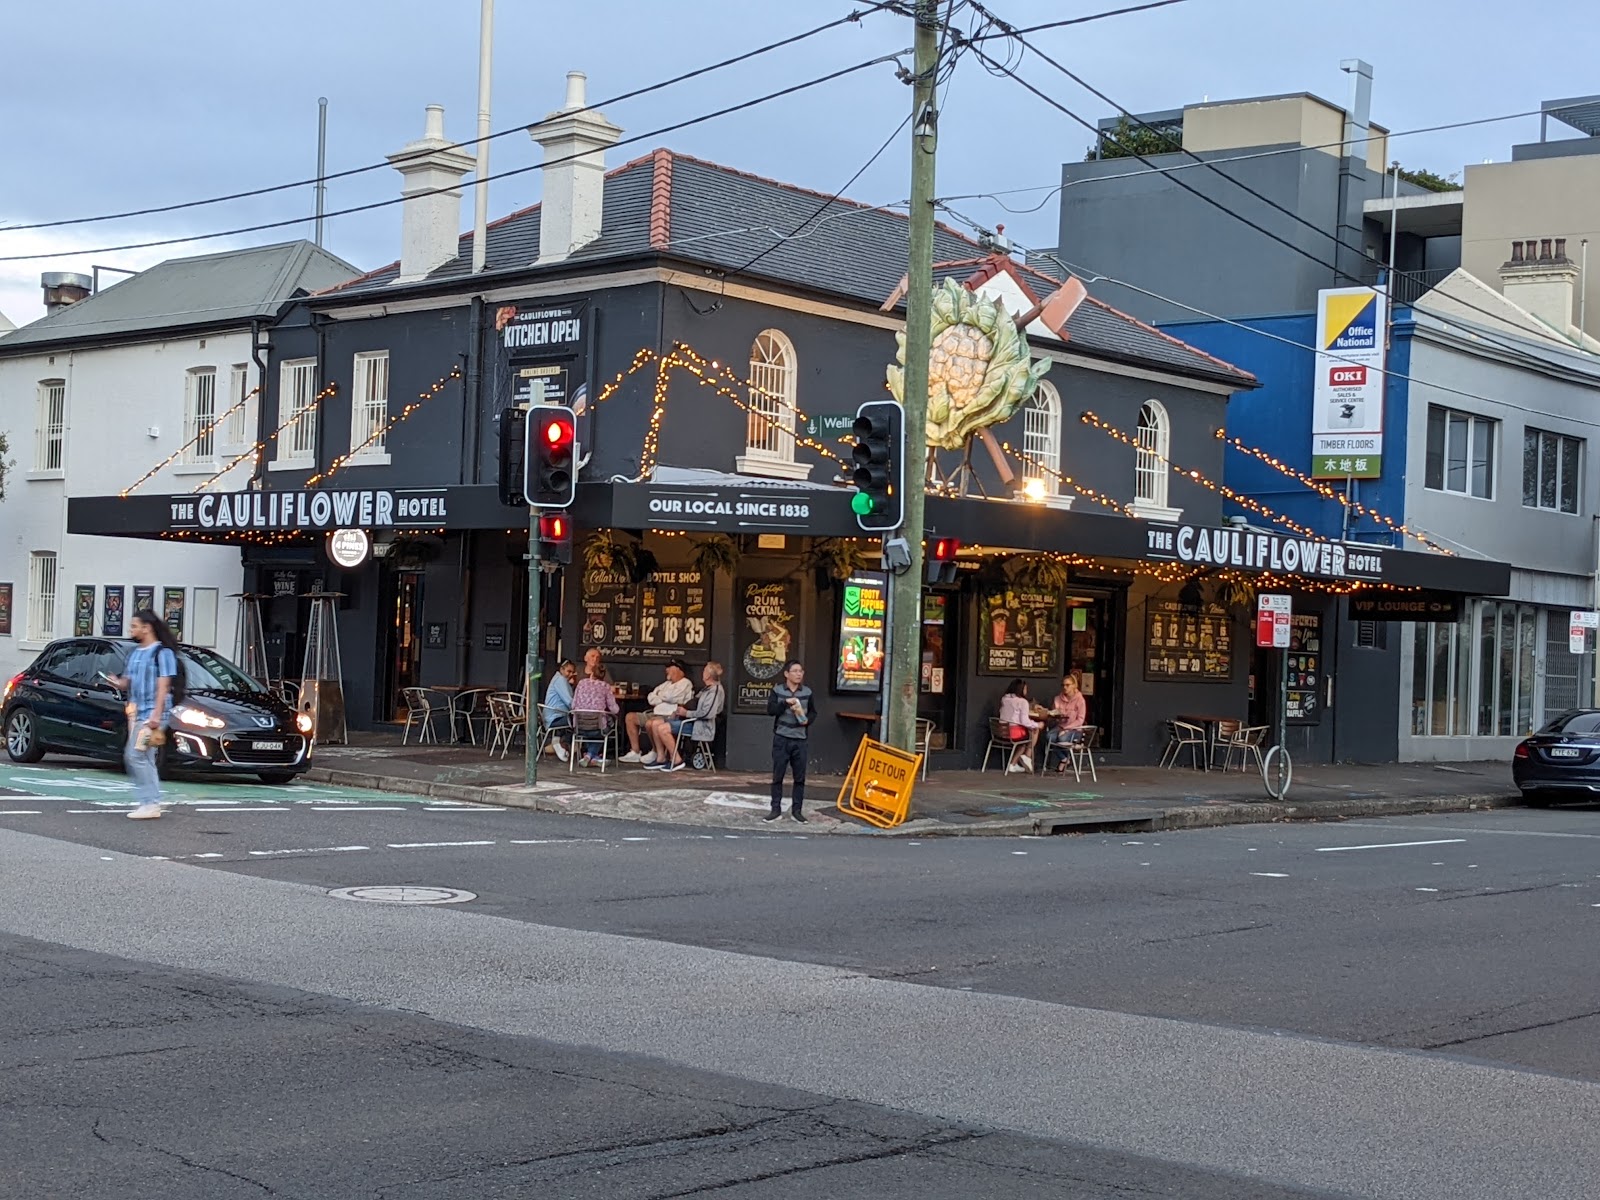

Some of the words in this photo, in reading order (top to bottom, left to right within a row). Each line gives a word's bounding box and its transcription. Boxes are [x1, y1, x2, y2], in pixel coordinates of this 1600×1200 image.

[520, 310, 562, 320] CAULIFLOWER
[504, 322, 549, 348] KITCHEN
[551, 319, 580, 343] OPEN
[1348, 327, 1373, 336] Office
[1337, 336, 1373, 347] National
[1333, 371, 1363, 381] OKI
[1320, 440, 1345, 449] TIMBER
[1347, 440, 1374, 449] FLOORS
[1324, 458, 1367, 472] 木地板
[171, 503, 194, 520] THE
[198, 491, 394, 527] CAULIFLOWER
[398, 498, 447, 517] HOTEL
[649, 499, 682, 513] OUR
[685, 501, 734, 515] LOCAL
[735, 502, 777, 516] SINCE
[779, 504, 809, 518] 1838
[1148, 531, 1172, 550] THE
[1176, 526, 1346, 576] CAULIFLOWER
[1348, 554, 1383, 572] HOTEL
[590, 570, 613, 583] Cellar
[678, 572, 701, 583] SHOP
[274, 581, 295, 590] WINE
[746, 583, 784, 598] Rooftop
[861, 589, 881, 600] FOOTY
[754, 596, 779, 606] RUM
[861, 599, 884, 610] TIPPING
[1355, 602, 1374, 610] VIP
[1378, 602, 1425, 611] LOUNGE
[746, 606, 780, 615] COCKTAIL
[1291, 614, 1319, 627] SPORTS
[990, 649, 1014, 657] FUNCTION
[1287, 709, 1304, 718] RAFFLE
[869, 758, 906, 781] DETOUR
